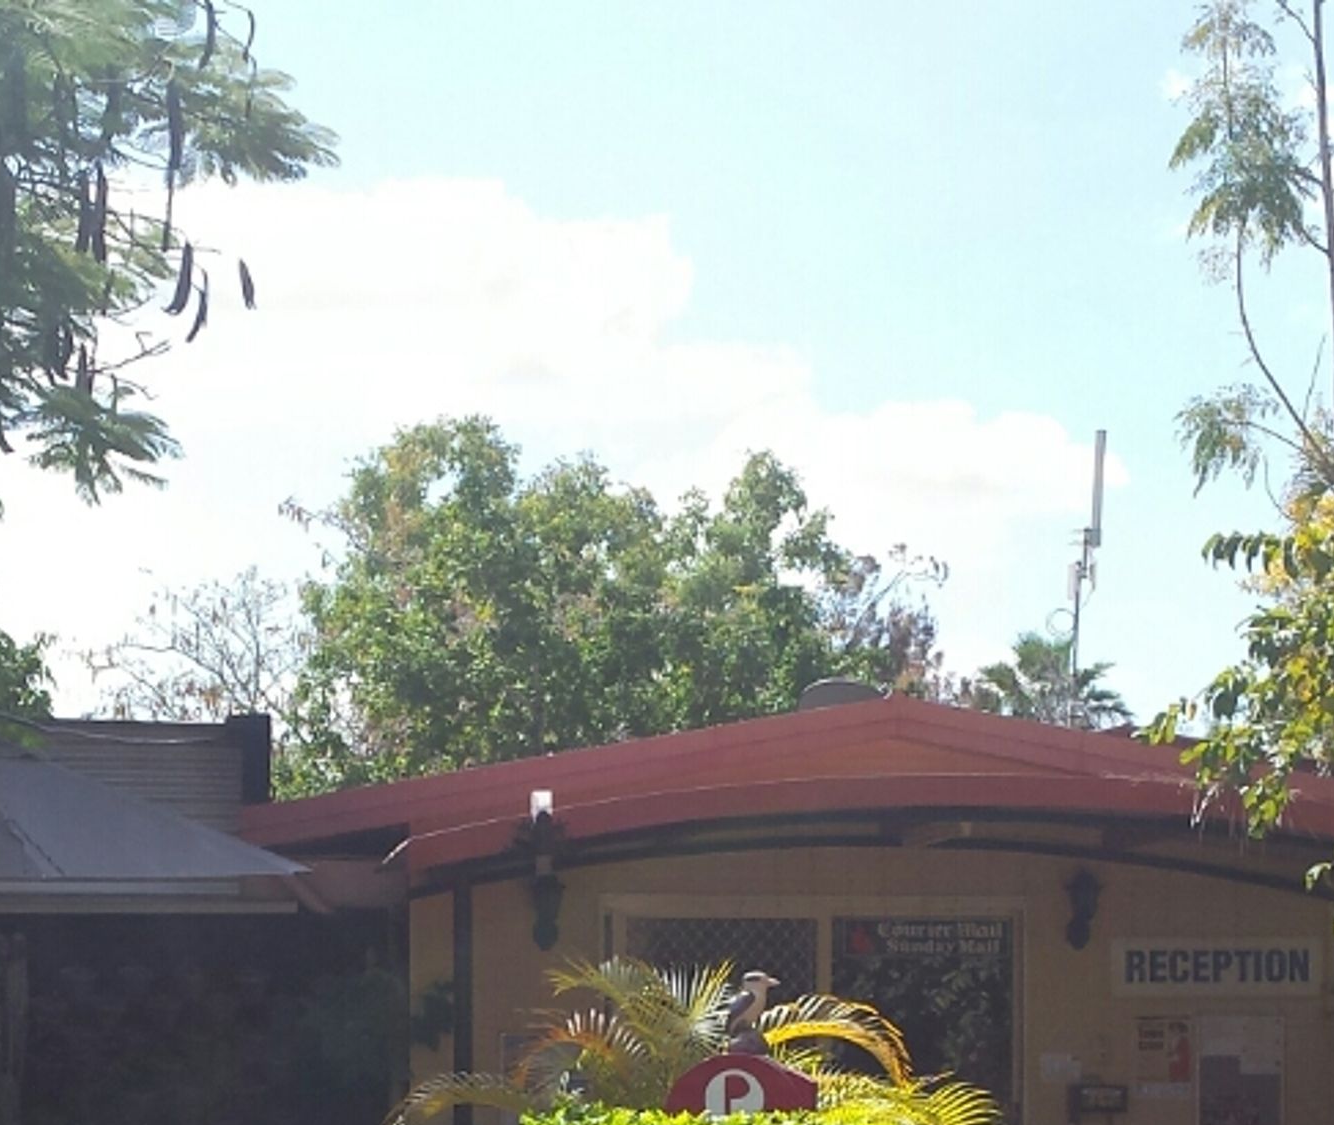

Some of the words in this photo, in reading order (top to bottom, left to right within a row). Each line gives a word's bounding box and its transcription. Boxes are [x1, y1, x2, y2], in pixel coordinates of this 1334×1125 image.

[877, 922, 953, 938] Courier
[957, 921, 1003, 938] Mail
[886, 939, 955, 956] Sunday
[959, 939, 1001, 954] Mail
[1124, 949, 1310, 983] RECEPTION
